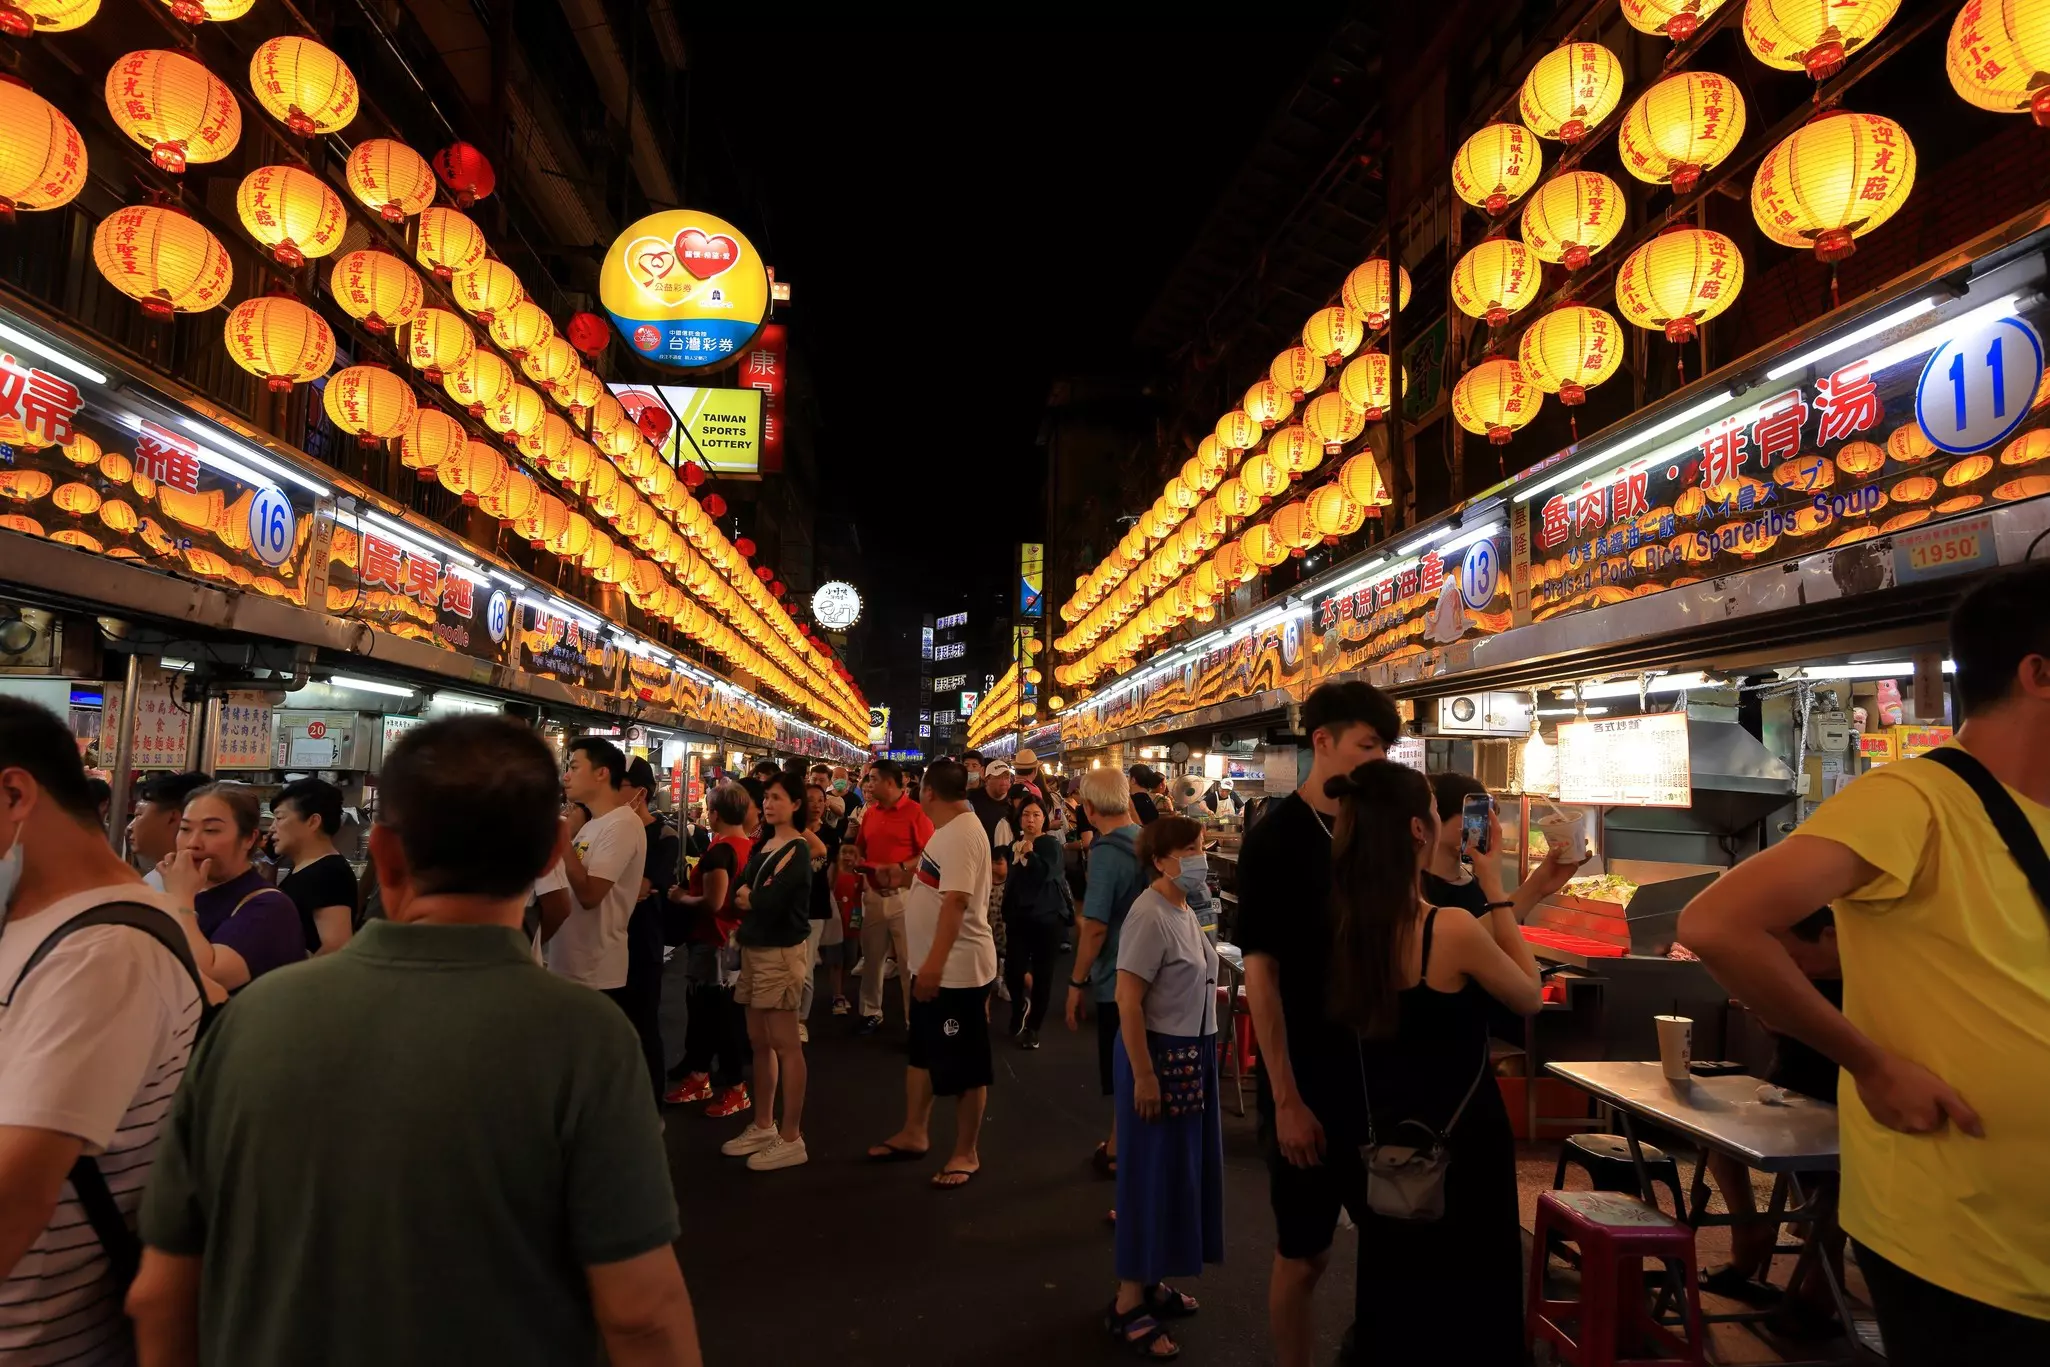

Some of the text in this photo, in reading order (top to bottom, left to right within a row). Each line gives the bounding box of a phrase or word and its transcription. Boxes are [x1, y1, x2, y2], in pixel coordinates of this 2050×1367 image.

[1697, 79, 1725, 141] 開漳聖王
[115, 214, 146, 277] 開漳聖王
[669, 337, 734, 352] 台灣彩券
[342, 376, 365, 423] 開漳聖王
[1949, 337, 2006, 432] 11
[702, 426, 747, 436] SPORTS
[703, 413, 747, 424] TAIWAN
[701, 438, 752, 449] LOTTERY
[260, 498, 286, 554] 16
[1600, 560, 1637, 585] Pork
[1813, 484, 1880, 524] Soup
[1917, 537, 1973, 566] 1950
[360, 532, 475, 620] 廣東麵
[1469, 549, 1491, 598] 13
[491, 602, 505, 637] 18
[1286, 627, 1296, 658] 15
[309, 725, 325, 735] 20
